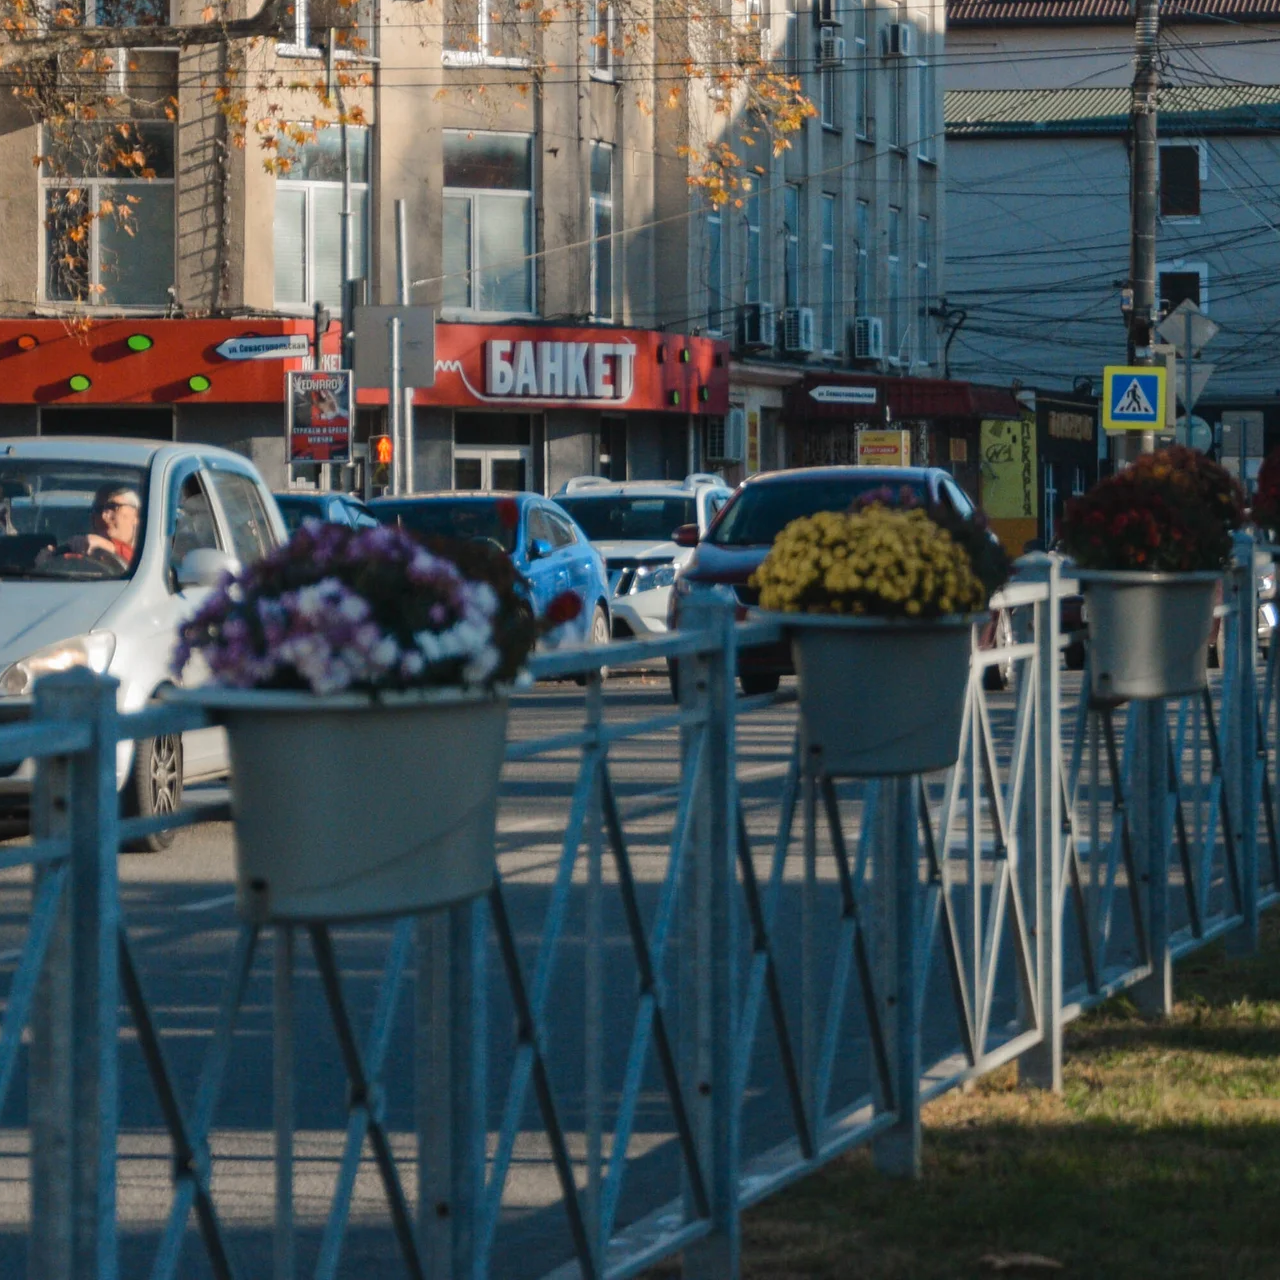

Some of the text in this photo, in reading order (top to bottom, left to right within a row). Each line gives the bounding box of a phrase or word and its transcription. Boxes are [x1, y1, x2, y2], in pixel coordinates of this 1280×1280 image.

[239, 341, 306, 353] Севастопольская
[302, 378, 337, 391] EDWARD
[487, 339, 637, 398] БАНКЕТ
[1021, 422, 1033, 516] ПЕКАРНЯ
